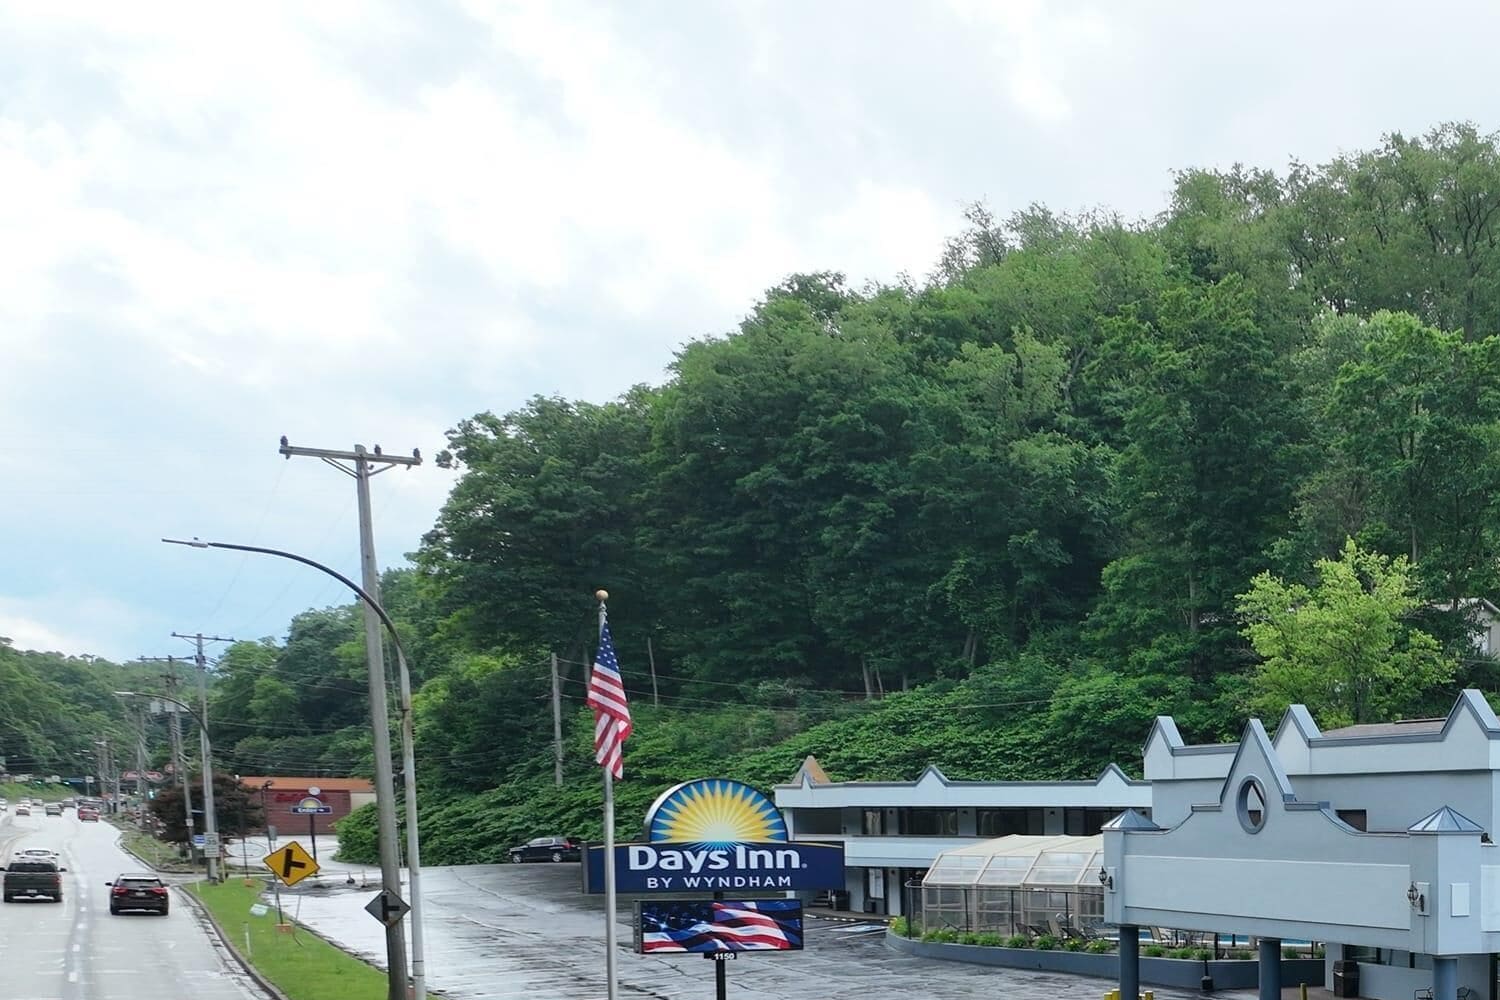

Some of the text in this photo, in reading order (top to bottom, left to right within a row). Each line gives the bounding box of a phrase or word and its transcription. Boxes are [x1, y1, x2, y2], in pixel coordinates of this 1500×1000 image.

[628, 846, 801, 874] Days Inn
[647, 876, 791, 889] BY WYNDHAM
